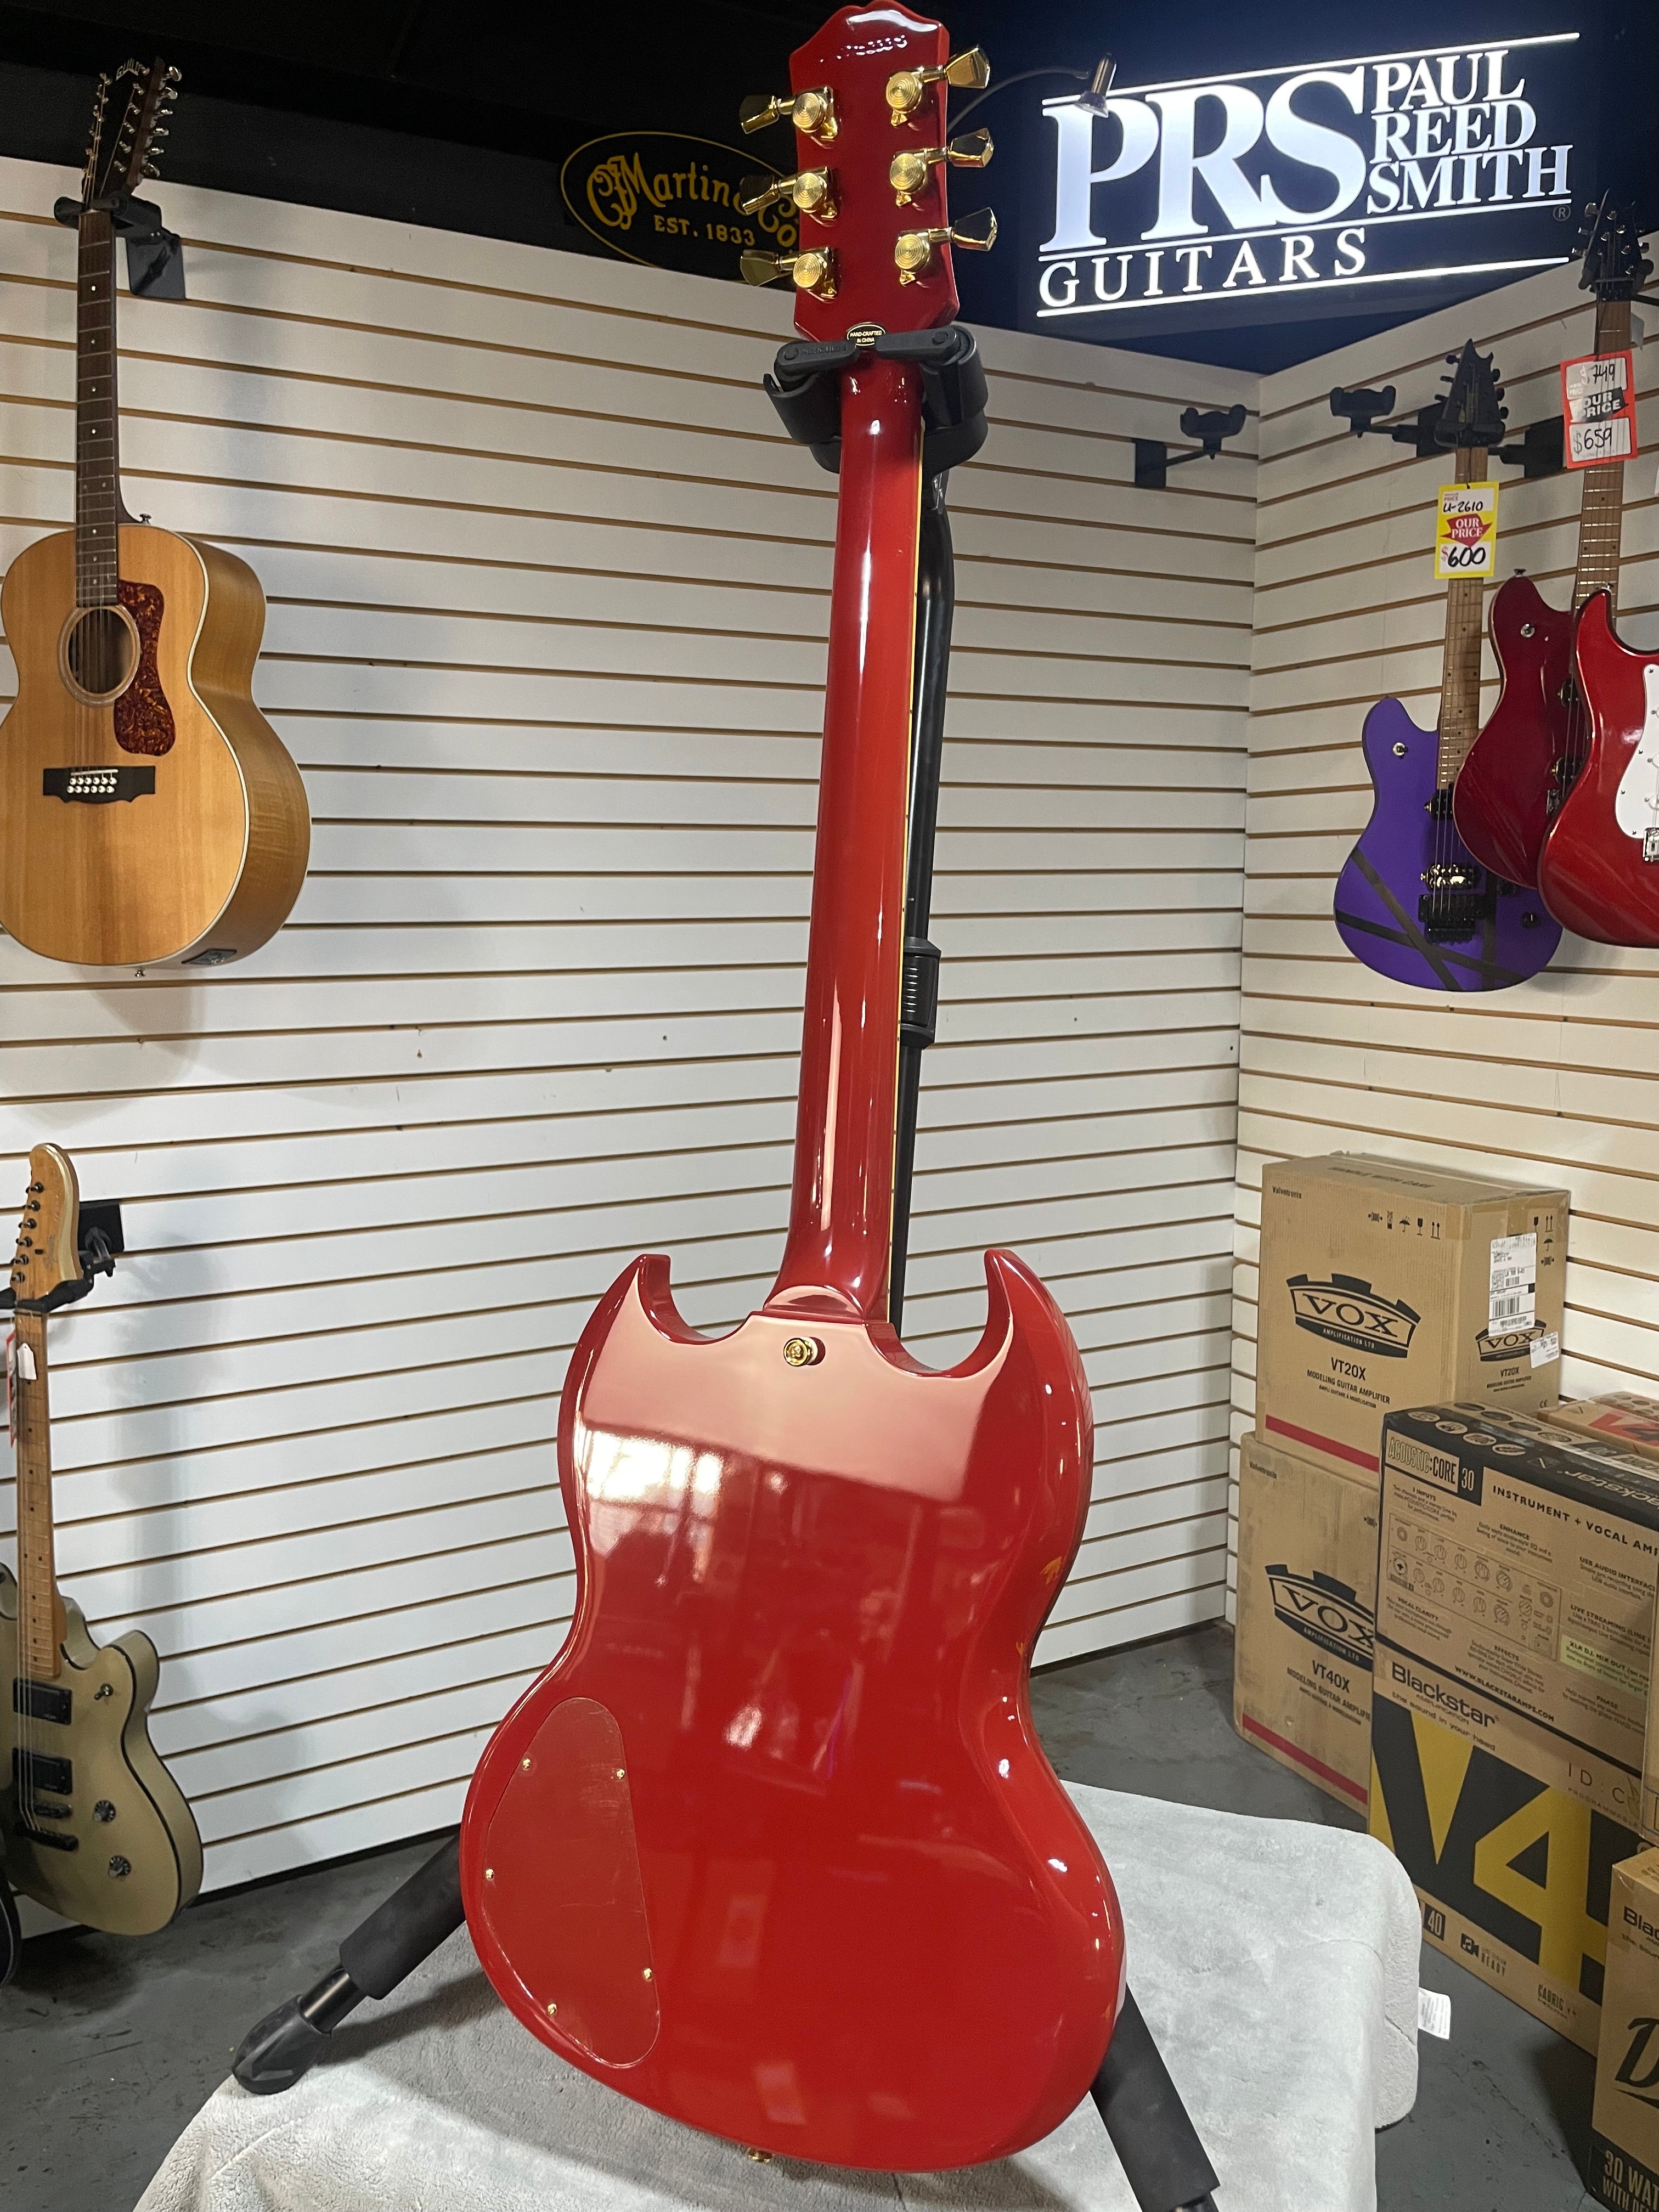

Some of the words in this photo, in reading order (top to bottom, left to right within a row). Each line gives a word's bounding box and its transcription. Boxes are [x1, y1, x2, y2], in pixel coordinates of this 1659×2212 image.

[1372, 50, 1526, 114] PAUL
[1372, 100, 1536, 164] REED
[1040, 66, 1366, 253] PRS
[1366, 145, 1572, 214] SMITH
[654, 214, 698, 238] EST.
[707, 223, 755, 247] 1833
[1039, 227, 1366, 307] GUITARS
[1583, 392, 1612, 409] OUR
[1573, 426, 1612, 455] $659
[1452, 527, 1483, 538] PRICE
[1455, 518, 1479, 528] OUR
[1272, 1186, 1302, 1199] Valvetronix
[1302, 1293, 1398, 1338] VOX
[1323, 1328, 1363, 1345] AMPLIFICATION
[1484, 1331, 1537, 1348] VOX
[1331, 1357, 1366, 1381] VT20X
[1500, 1366, 1520, 1377] VT20X
[1307, 1369, 1335, 1385] MODELING
[1336, 1379, 1358, 1393] GUITAR
[1359, 1387, 1390, 1404] AMPLIFIER
[1461, 1468, 1475, 1492] 30
[1493, 1485, 1570, 1521] INSTRUMENT
[1586, 1520, 1628, 1545] VOCAL
[1579, 1556, 1593, 1566] USB
[1594, 1563, 1617, 1575] AUDIO
[1282, 1584, 1374, 1647] VOX
[1571, 1604, 1585, 1614] LIVE
[1587, 1611, 1626, 1632] STREAMING
[1304, 1627, 1346, 1655] AMPLIFICATION
[1312, 1660, 1350, 1693] VT40X
[1596, 1654, 1609, 1663] MIX
[1611, 1660, 1626, 1671] OUT
[1392, 1661, 1496, 1728] Blackstar
[1392, 1691, 1407, 1703] the
[1410, 1702, 1436, 1719] sound
[1439, 1716, 1447, 1724] in
[1450, 1723, 1470, 1736] your
[1473, 1734, 1496, 1751] head
[1427, 1910, 1443, 1936] 40
[1605, 2149, 1623, 2183] 30
[1603, 2176, 1629, 2211] WITH
